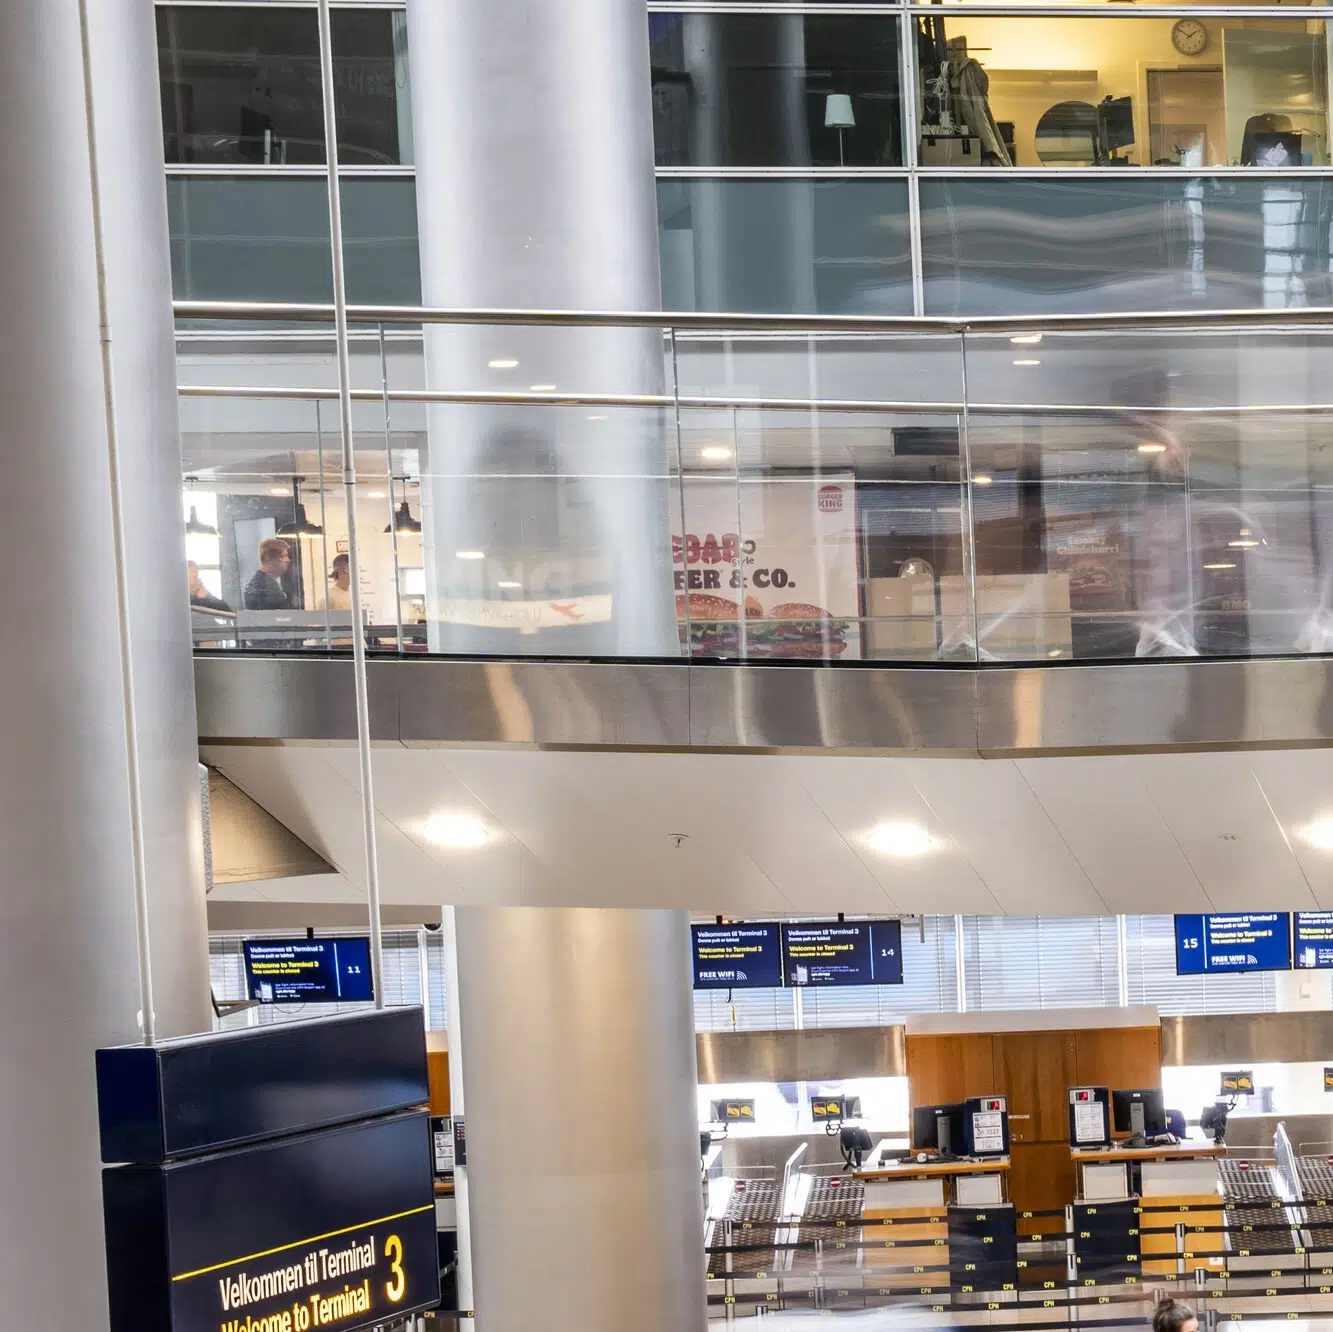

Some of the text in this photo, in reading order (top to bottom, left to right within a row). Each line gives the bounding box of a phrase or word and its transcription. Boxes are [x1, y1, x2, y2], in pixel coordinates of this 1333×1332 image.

[817, 500, 843, 508] KING
[729, 569, 748, 588] &
[752, 568, 796, 589] CO.
[1184, 938, 1198, 948] 15
[347, 966, 360, 974] 11
[219, 1234, 405, 1311] Velkommen til Terminal 3
[1099, 1296, 1109, 1304] CPH
[293, 1302, 309, 1332] to
[310, 1279, 370, 1326] Terminal
